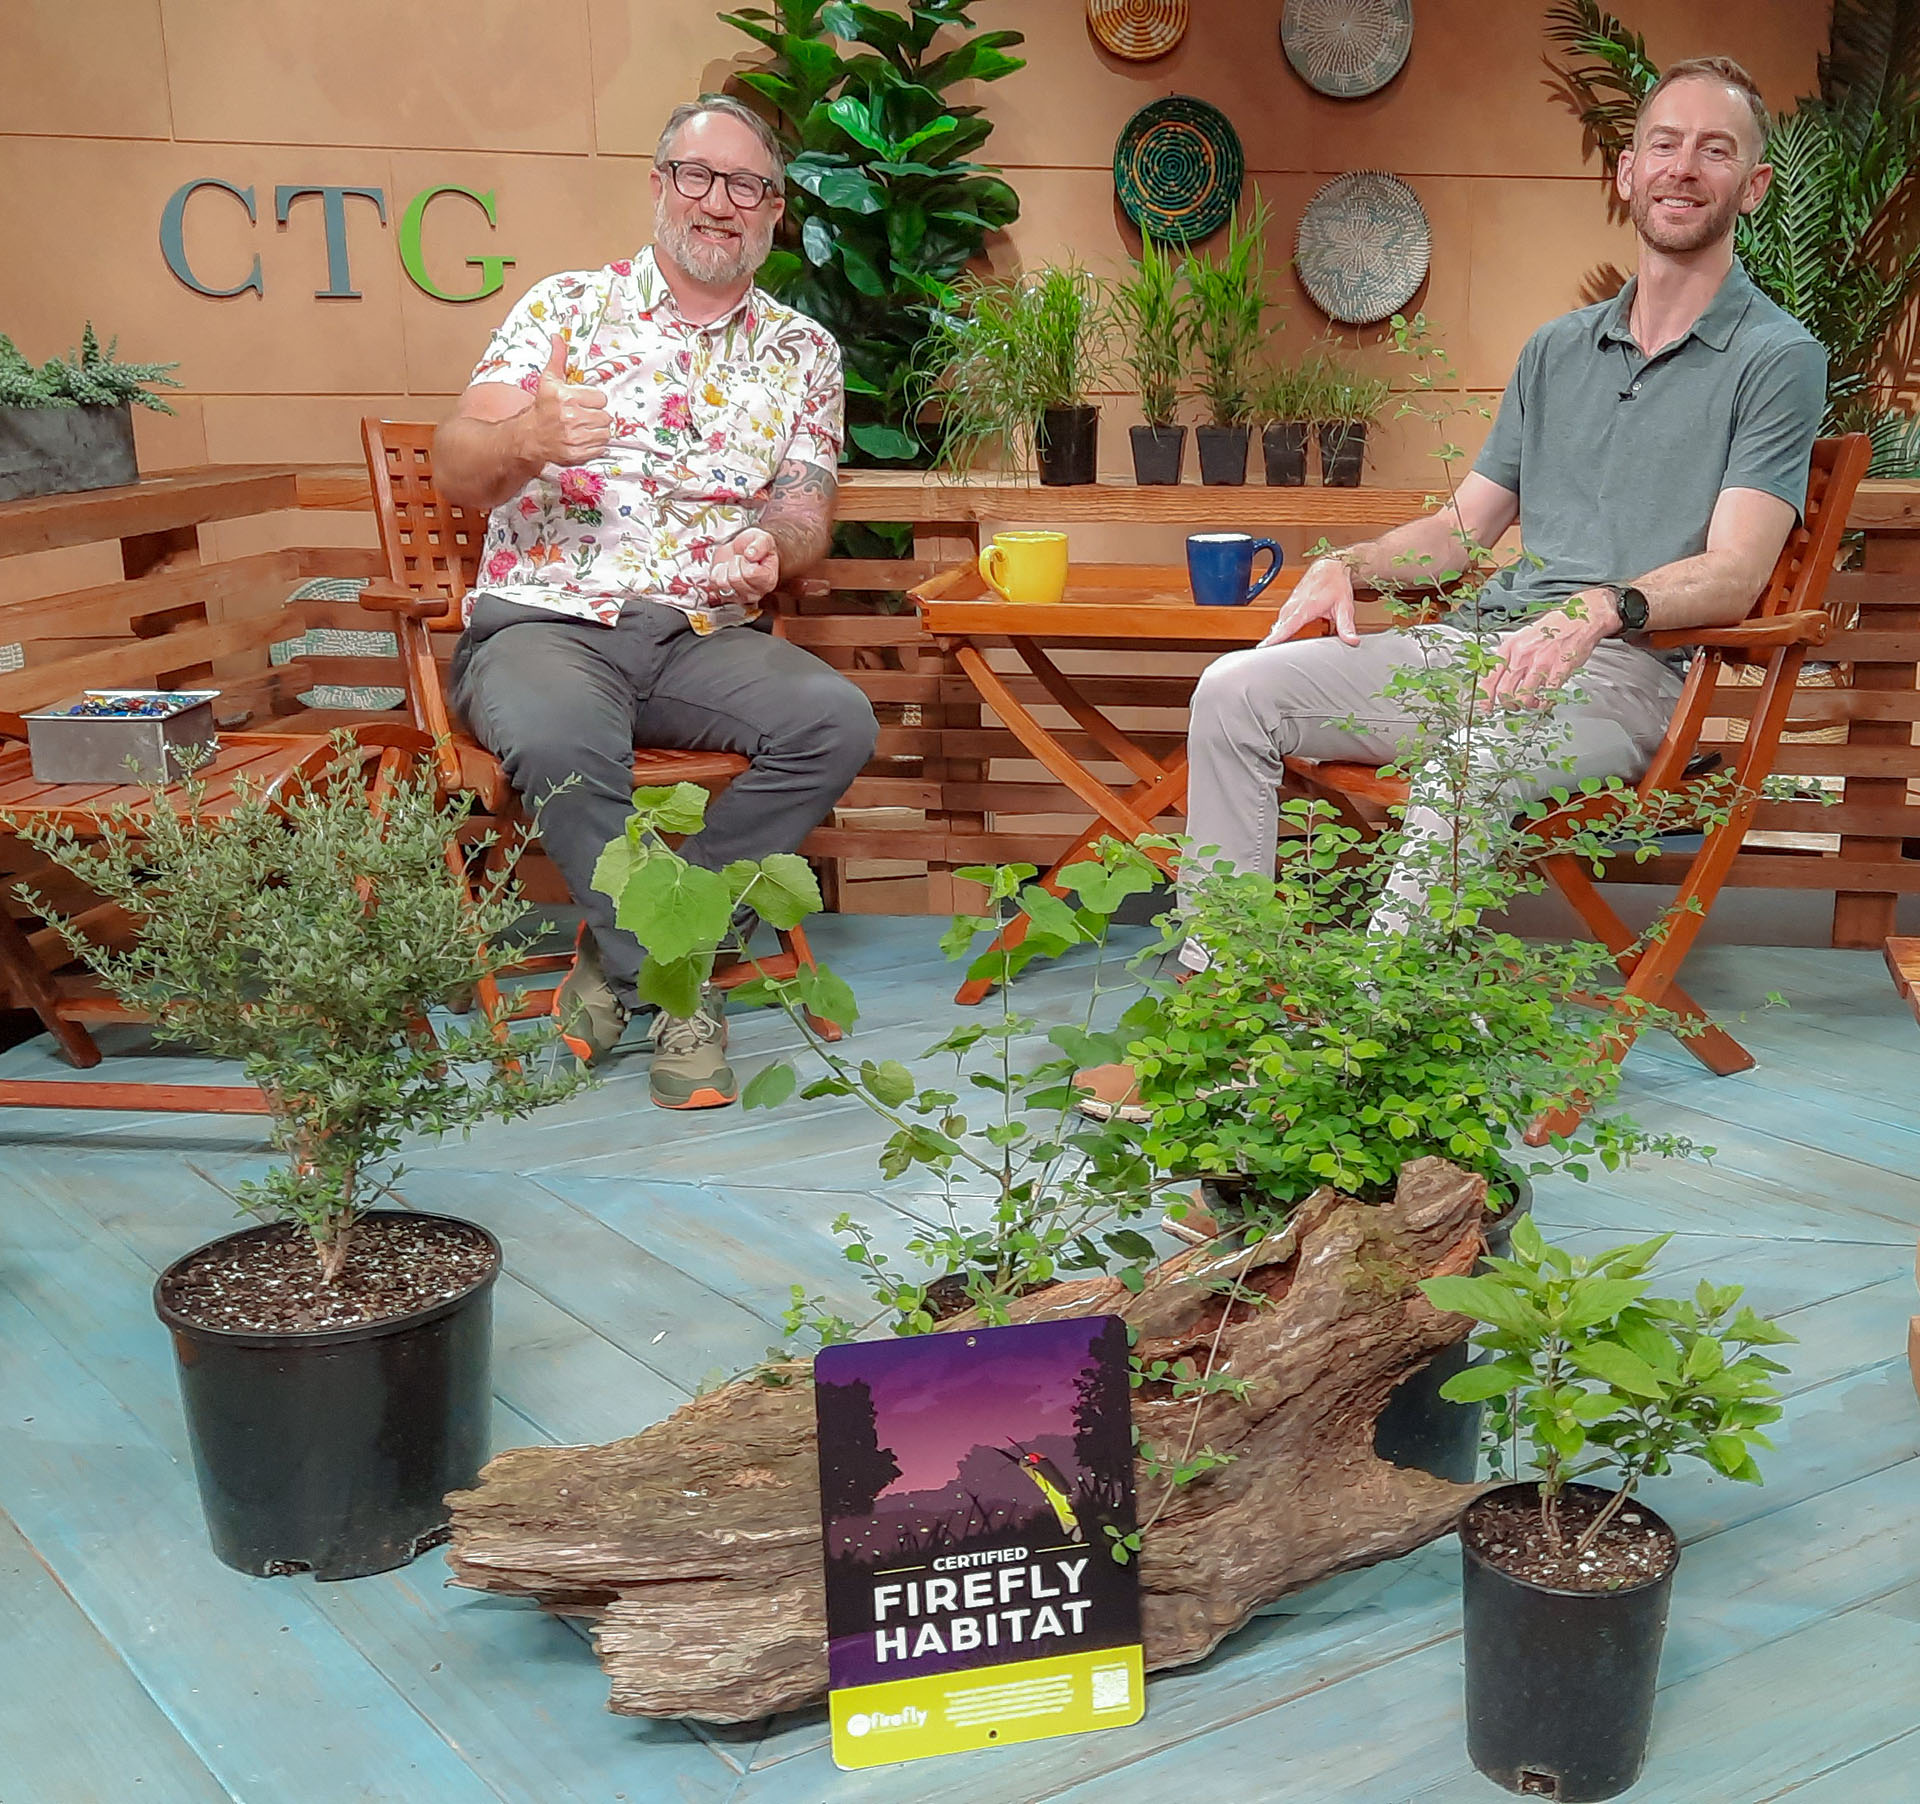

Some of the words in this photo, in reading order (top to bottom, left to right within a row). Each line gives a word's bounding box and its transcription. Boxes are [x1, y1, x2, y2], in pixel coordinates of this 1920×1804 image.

[160, 178, 515, 301] CTG
[873, 1558, 1089, 1622] FIREFLY
[933, 1547, 1029, 1572] CERTIFIED
[875, 1600, 1092, 1663] HABITAT
[869, 1706, 928, 1728] firefly
